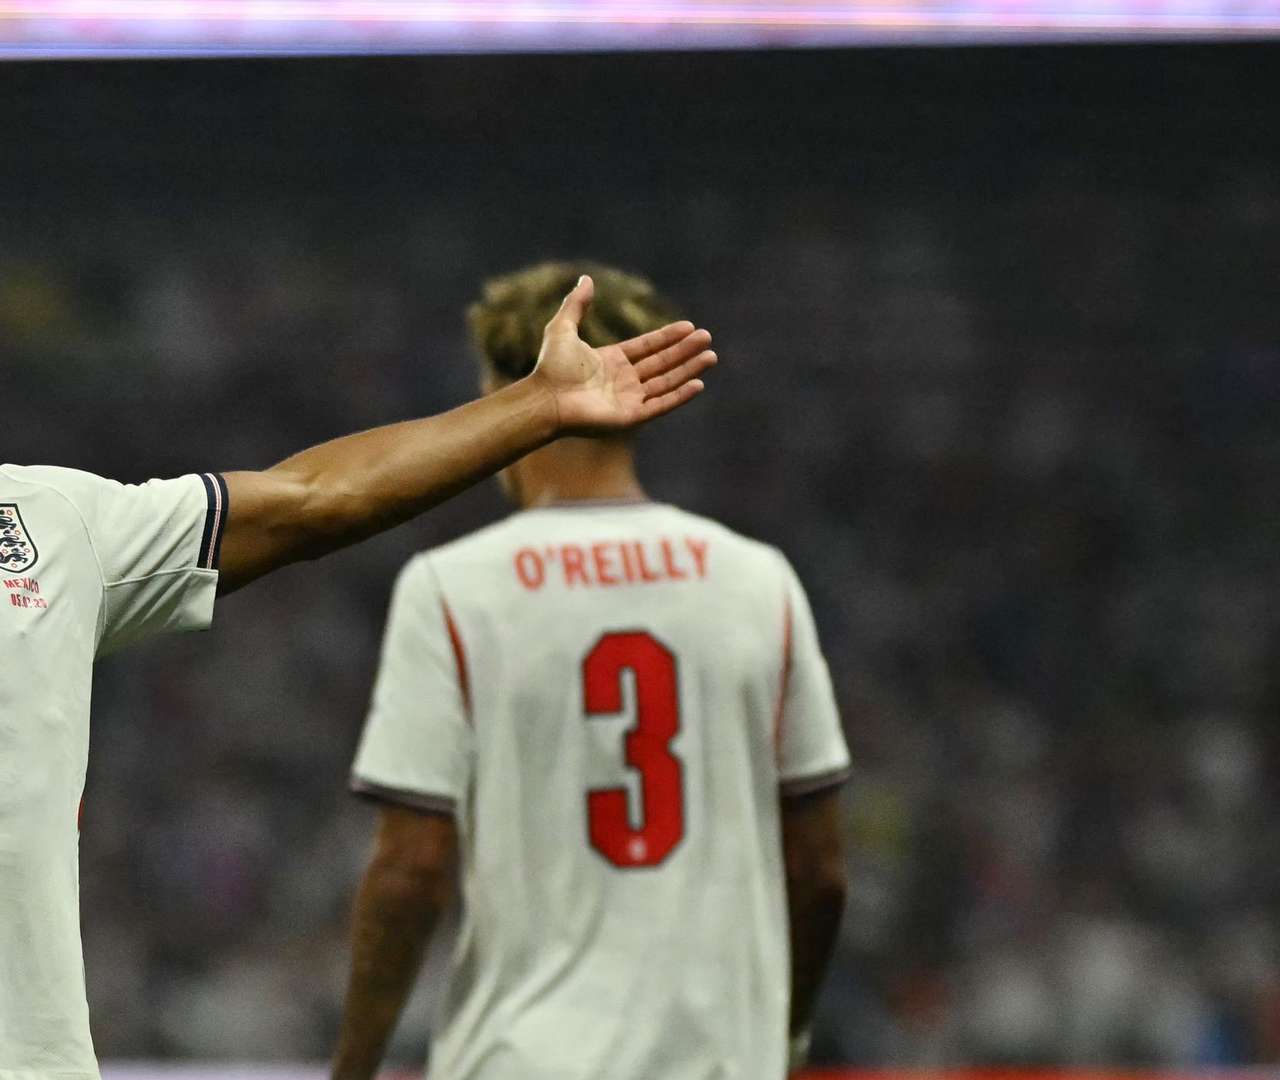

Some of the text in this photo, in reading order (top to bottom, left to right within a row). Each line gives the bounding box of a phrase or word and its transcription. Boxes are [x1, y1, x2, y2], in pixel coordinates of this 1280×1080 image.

[3, 577, 39, 593] MEXICO
[513, 534, 711, 590] O'REILLY
[581, 628, 687, 870] 3
